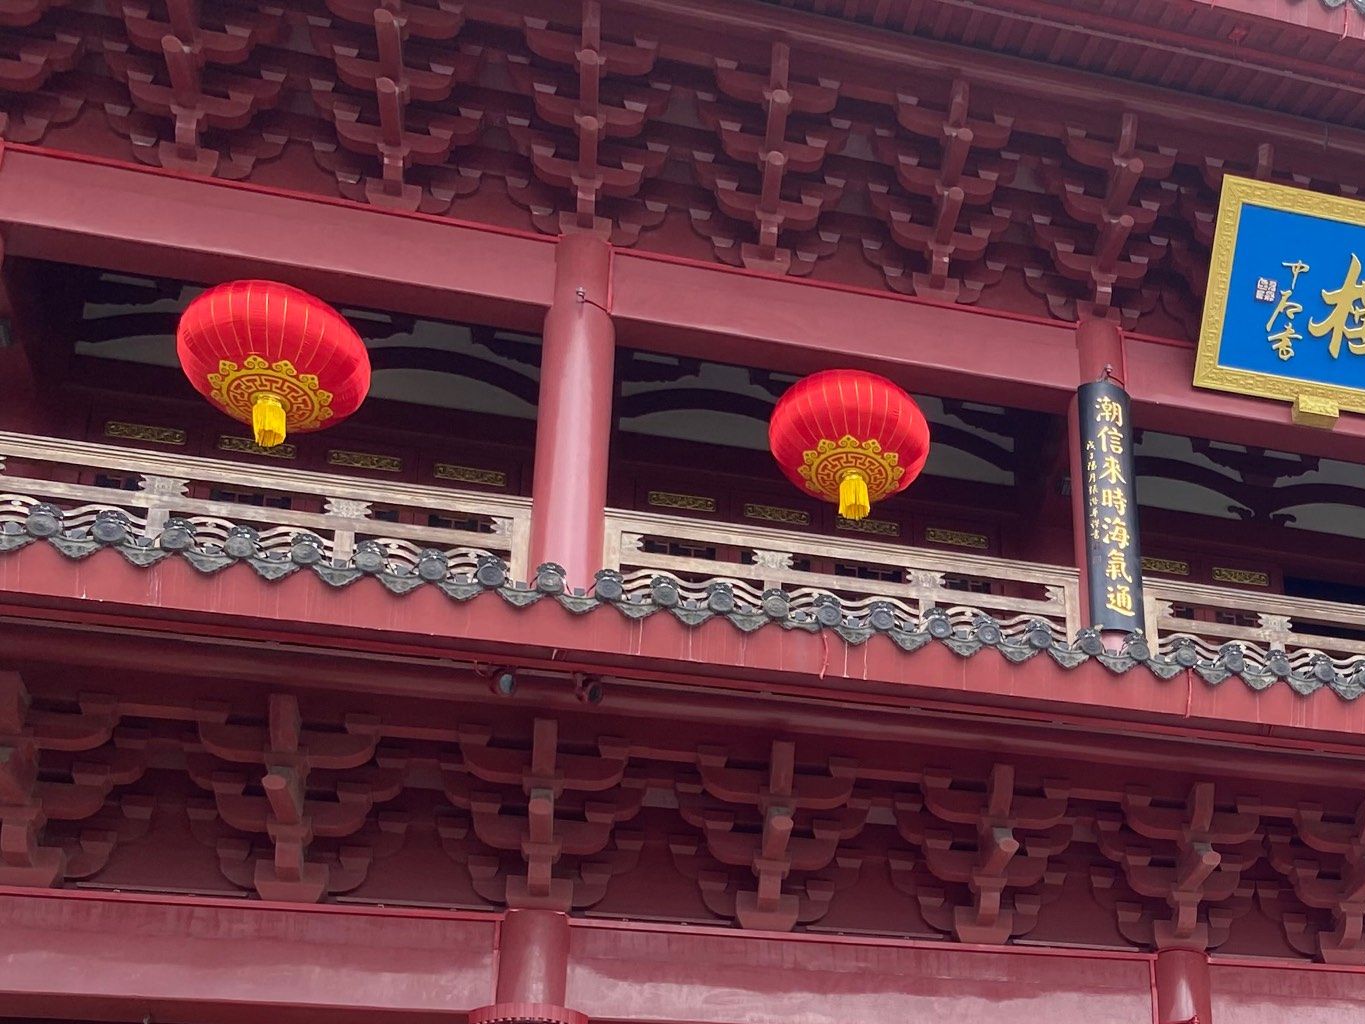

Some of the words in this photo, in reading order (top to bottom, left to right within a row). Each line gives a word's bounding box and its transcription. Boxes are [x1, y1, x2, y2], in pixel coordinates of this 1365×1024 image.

[1095, 397, 1135, 617] 潮信來時海氣通
